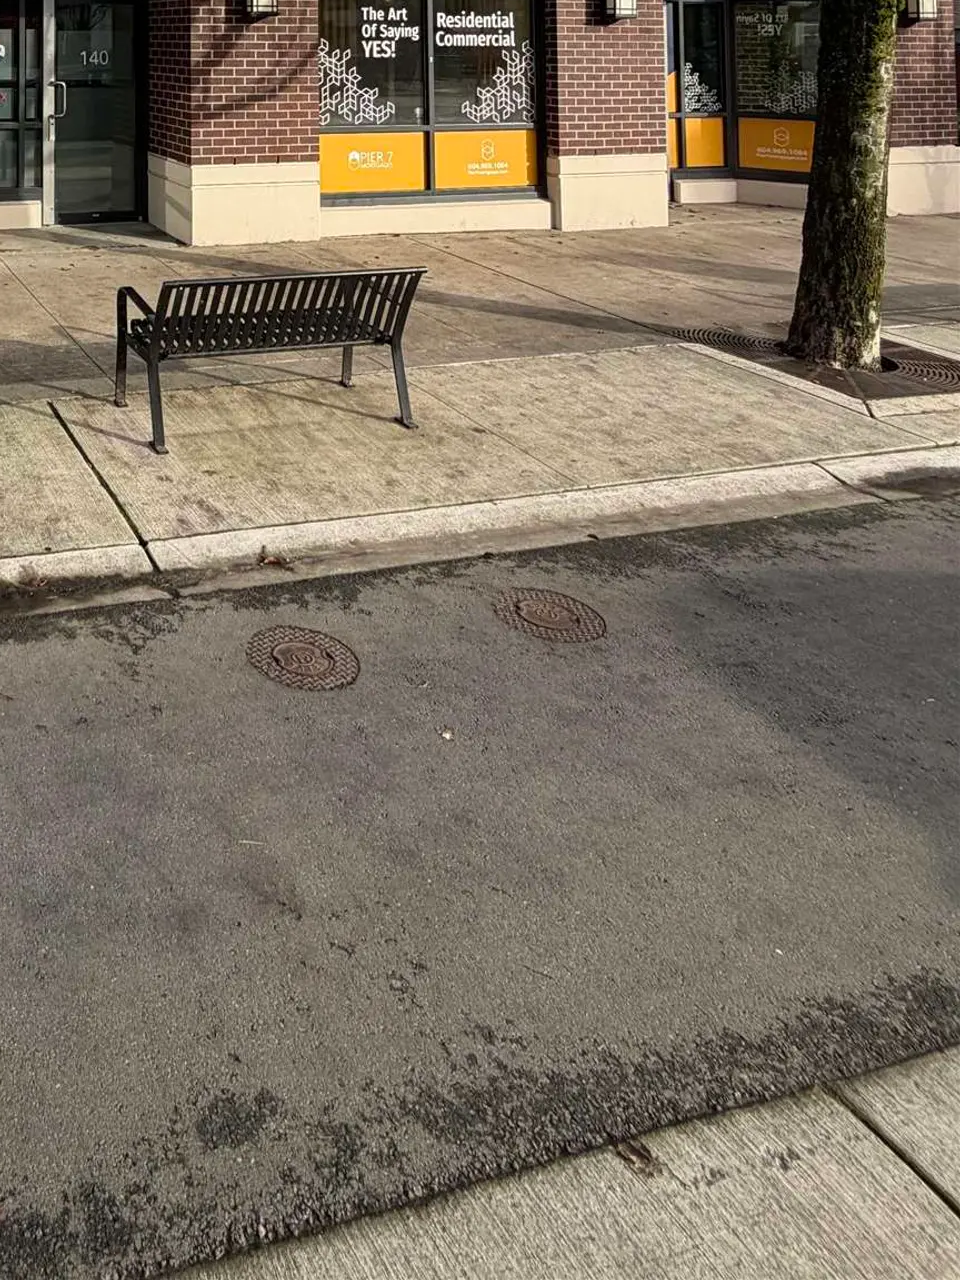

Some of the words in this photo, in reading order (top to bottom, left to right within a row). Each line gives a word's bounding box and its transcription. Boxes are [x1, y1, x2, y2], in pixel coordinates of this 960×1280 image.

[361, 7, 385, 21] The
[388, 7, 408, 21] Art
[436, 11, 515, 29] Residential
[361, 23, 378, 37] Of
[380, 23, 420, 41] Saying
[435, 30, 516, 47] Commercial
[80, 50, 109, 66] 140
[362, 41, 397, 58] YES!
[361, 151, 384, 163] PIER
[387, 151, 393, 163] 7
